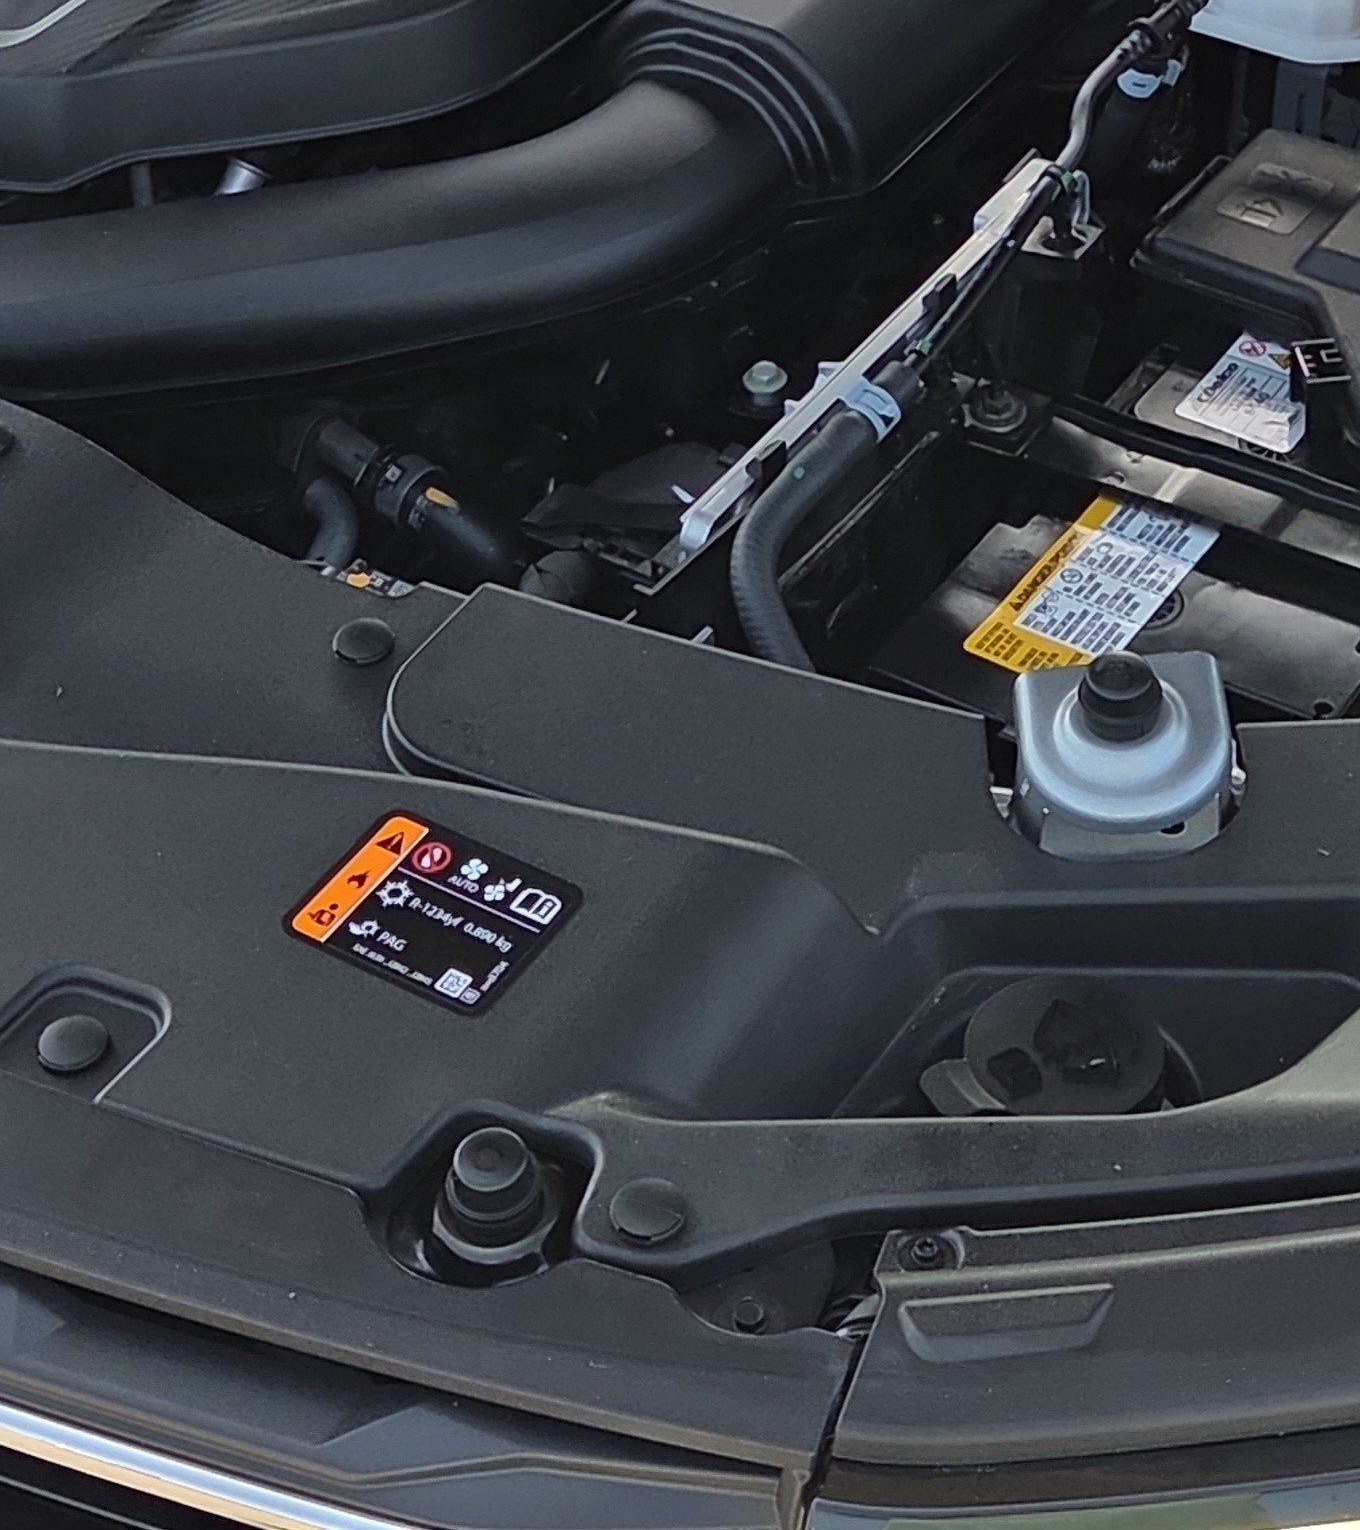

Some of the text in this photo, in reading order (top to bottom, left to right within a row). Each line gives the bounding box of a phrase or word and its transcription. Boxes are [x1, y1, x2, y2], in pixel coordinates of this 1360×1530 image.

[447, 874, 480, 894] AUTO
[377, 930, 408, 952] PAG
[496, 936, 513, 954] kg
